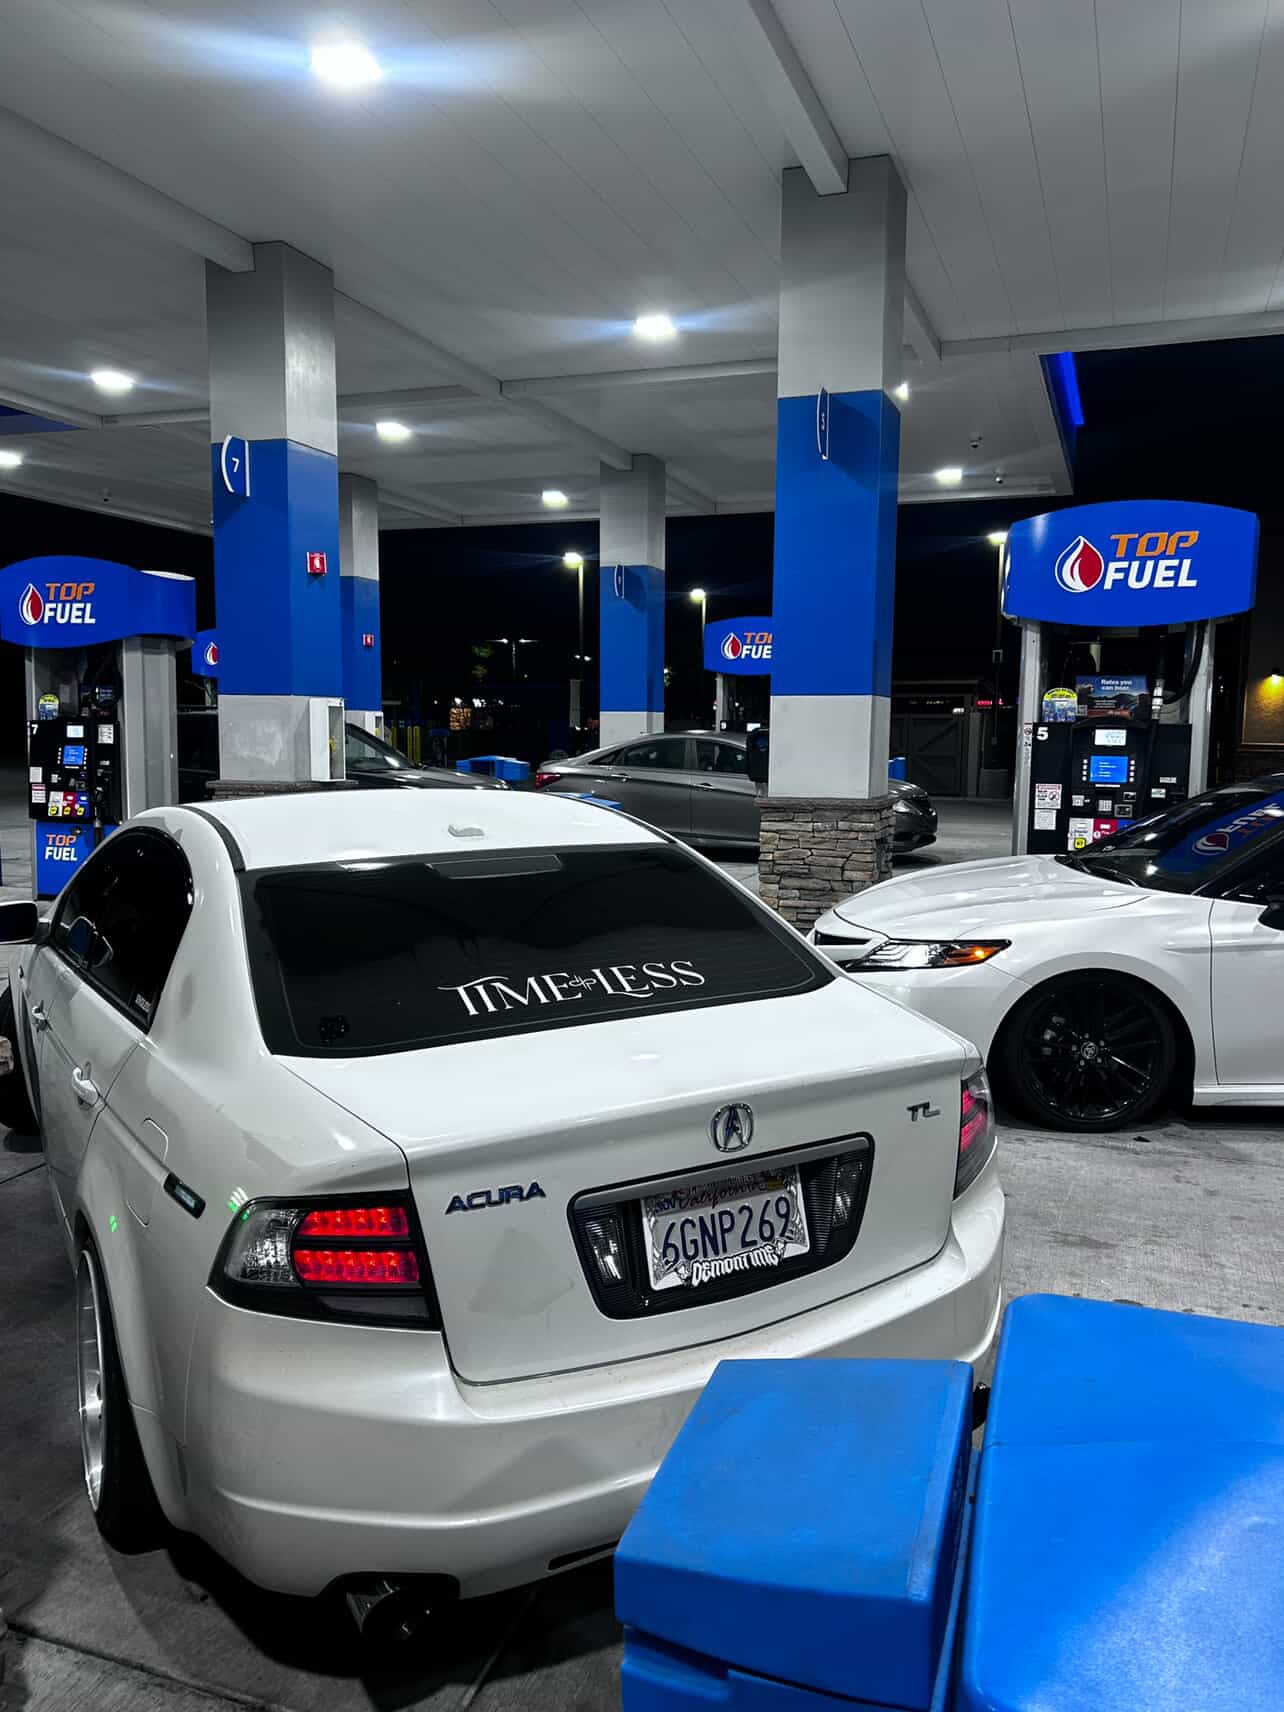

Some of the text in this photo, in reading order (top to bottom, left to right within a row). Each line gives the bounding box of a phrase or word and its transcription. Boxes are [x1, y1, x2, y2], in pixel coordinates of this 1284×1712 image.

[231, 457, 240, 473] 7
[1110, 531, 1200, 557] TOP
[1103, 558, 1198, 590] FUEL
[45, 582, 95, 601] TOP
[43, 602, 97, 624] FUEL
[741, 645, 773, 659] FUE
[31, 724, 39, 735] 7
[1036, 726, 1049, 741] 5
[46, 834, 77, 846] TOP
[45, 846, 78, 861] FUEL
[906, 1101, 941, 1122] TL
[445, 1182, 546, 1215] ACURA
[662, 1196, 791, 1265] 6GNP269
